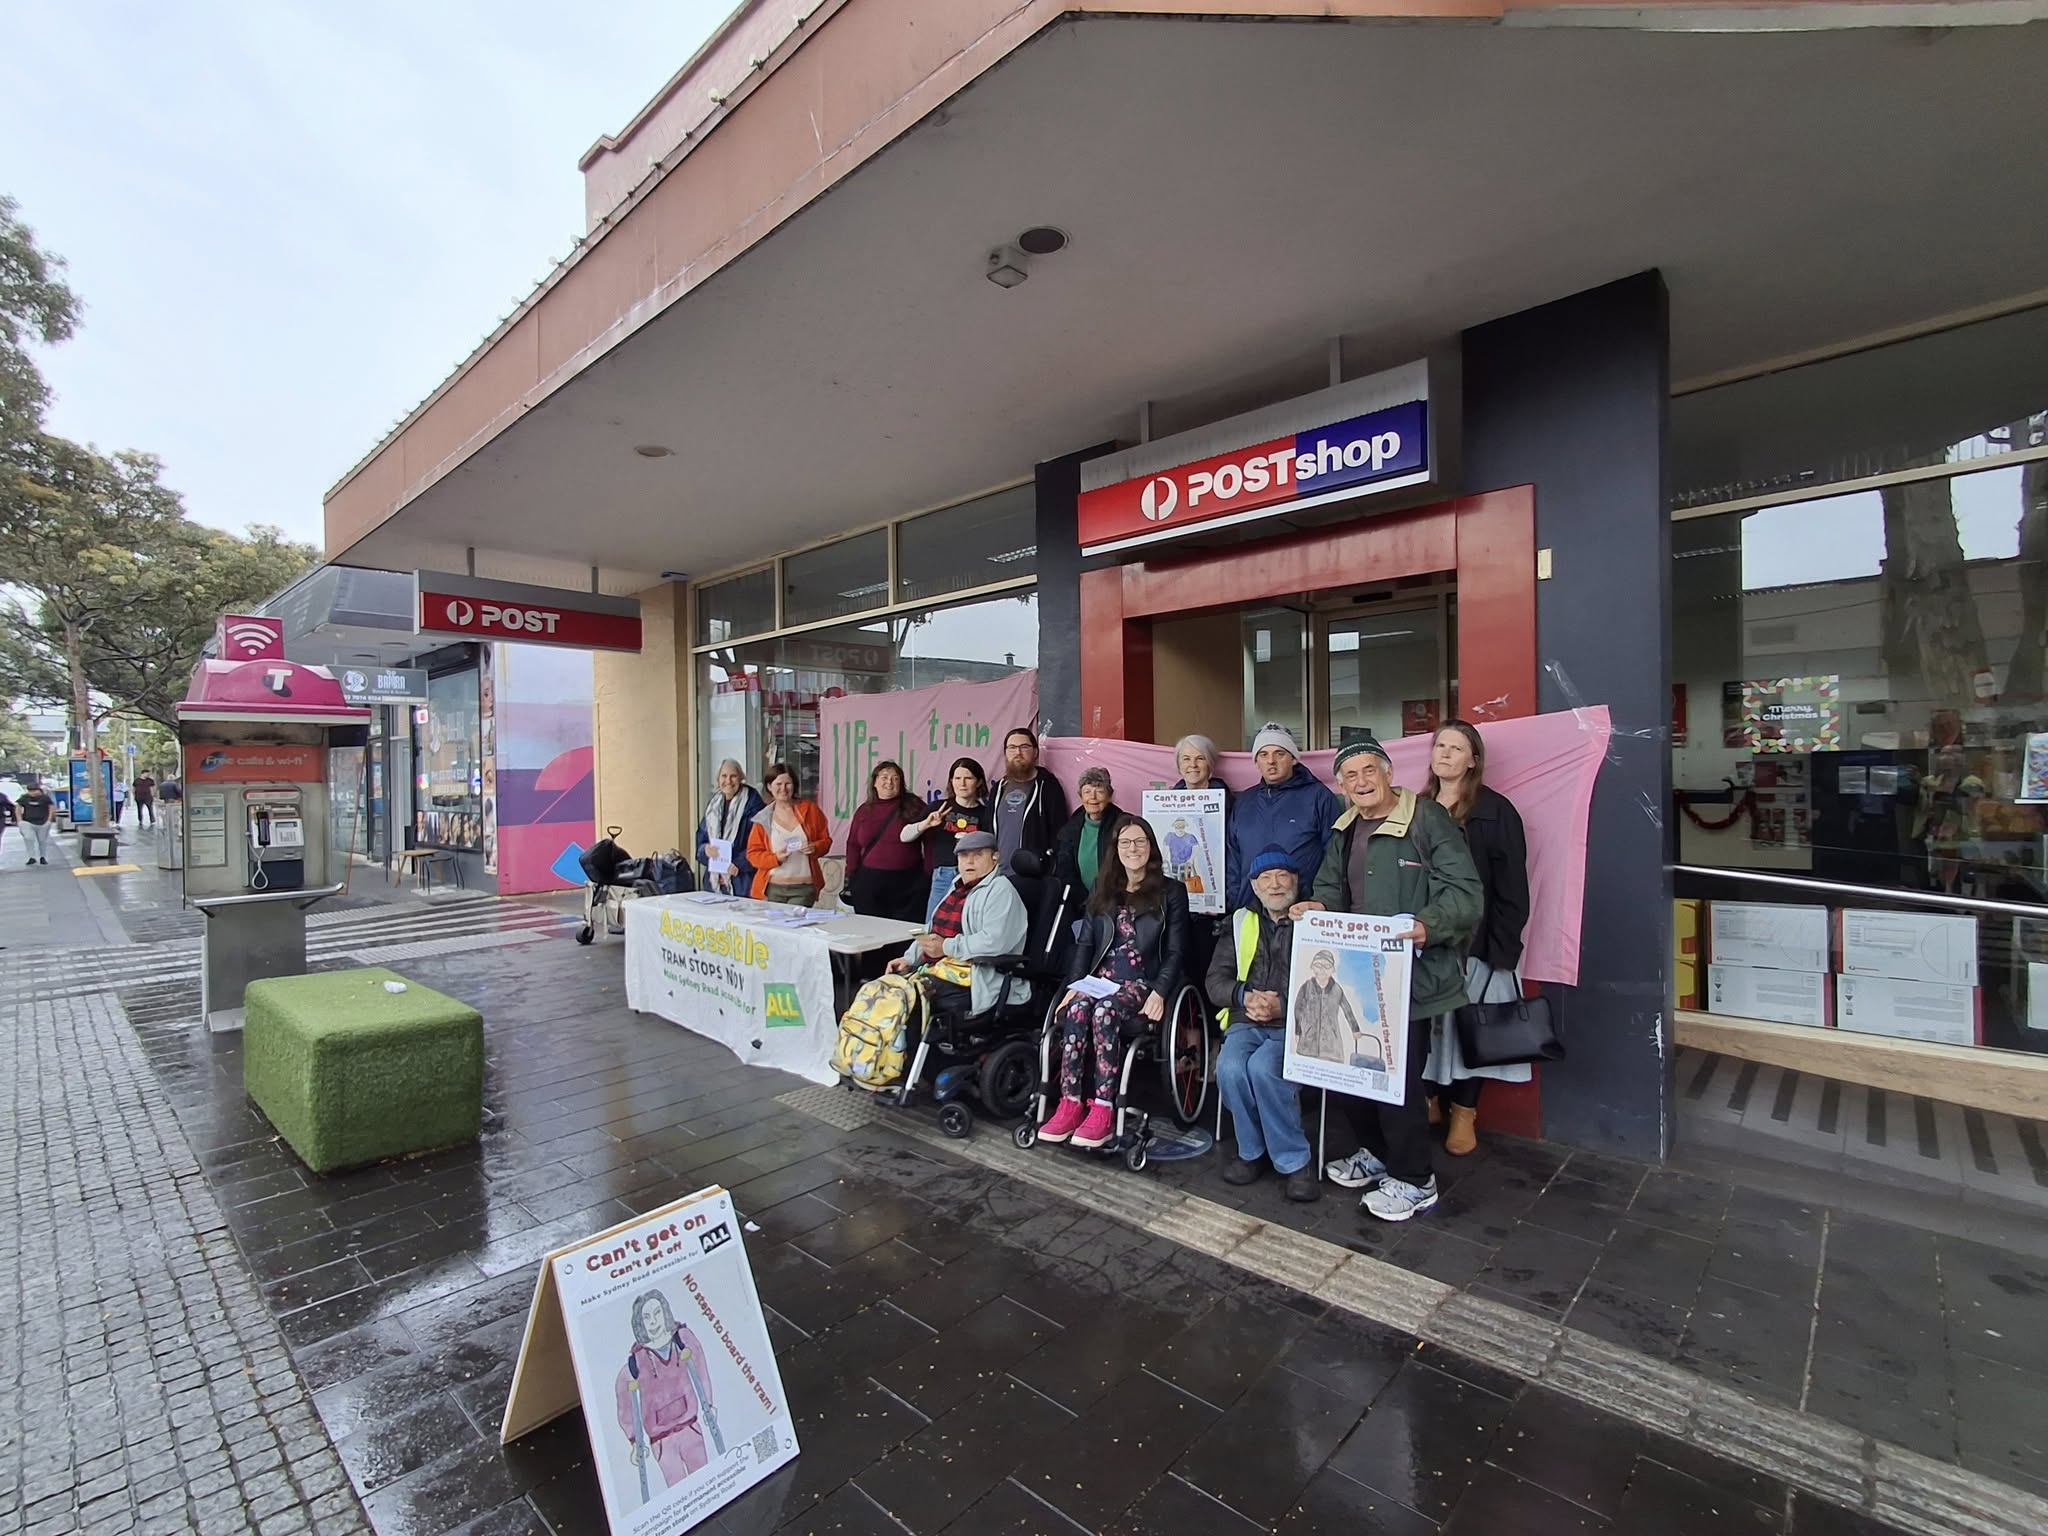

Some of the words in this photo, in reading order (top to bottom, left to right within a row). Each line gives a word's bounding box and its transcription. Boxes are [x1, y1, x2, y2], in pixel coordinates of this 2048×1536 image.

[1188, 431, 1401, 507] POSTshop
[481, 605, 561, 634] POST
[266, 668, 293, 690] T
[1762, 713, 1818, 721] Christmas
[1768, 705, 1814, 713] Merry
[928, 708, 991, 751] train
[1153, 794, 1178, 802] Can't
[1180, 795, 1196, 803] get
[1204, 804, 1218, 812] ALL
[660, 908, 769, 970] Accessible
[1310, 918, 1343, 929] Can't
[1347, 921, 1369, 932] get
[1373, 924, 1390, 933] on
[1382, 941, 1403, 950] ALL
[661, 947, 687, 969] TRAM
[689, 958, 723, 980] STOPS
[766, 992, 800, 1017] ALL
[586, 1238, 642, 1272] Can't
[646, 1223, 679, 1250] get
[683, 1213, 707, 1231] on
[702, 1227, 730, 1250] ALL
[610, 1259, 642, 1279] Can't
[644, 1250, 664, 1266] get
[666, 1240, 683, 1255] off
[580, 1293, 601, 1306] Make
[603, 1281, 631, 1297] Sydney
[632, 1271, 650, 1283] Road
[652, 1255, 687, 1275] accessible
[688, 1250, 699, 1258] for
[682, 1273, 698, 1293] NO
[694, 1292, 716, 1322] steps
[713, 1319, 724, 1334] to
[721, 1331, 746, 1366] board
[741, 1363, 755, 1383] the
[753, 1381, 773, 1411] tram
[682, 1486, 718, 1511] permanent
[717, 1465, 747, 1488] accessible
[632, 1518, 650, 1535] Scan
[650, 1511, 661, 1523] the
[661, 1505, 672, 1516] QR
[672, 1495, 689, 1510] code
[672, 1513, 690, 1528] stops
